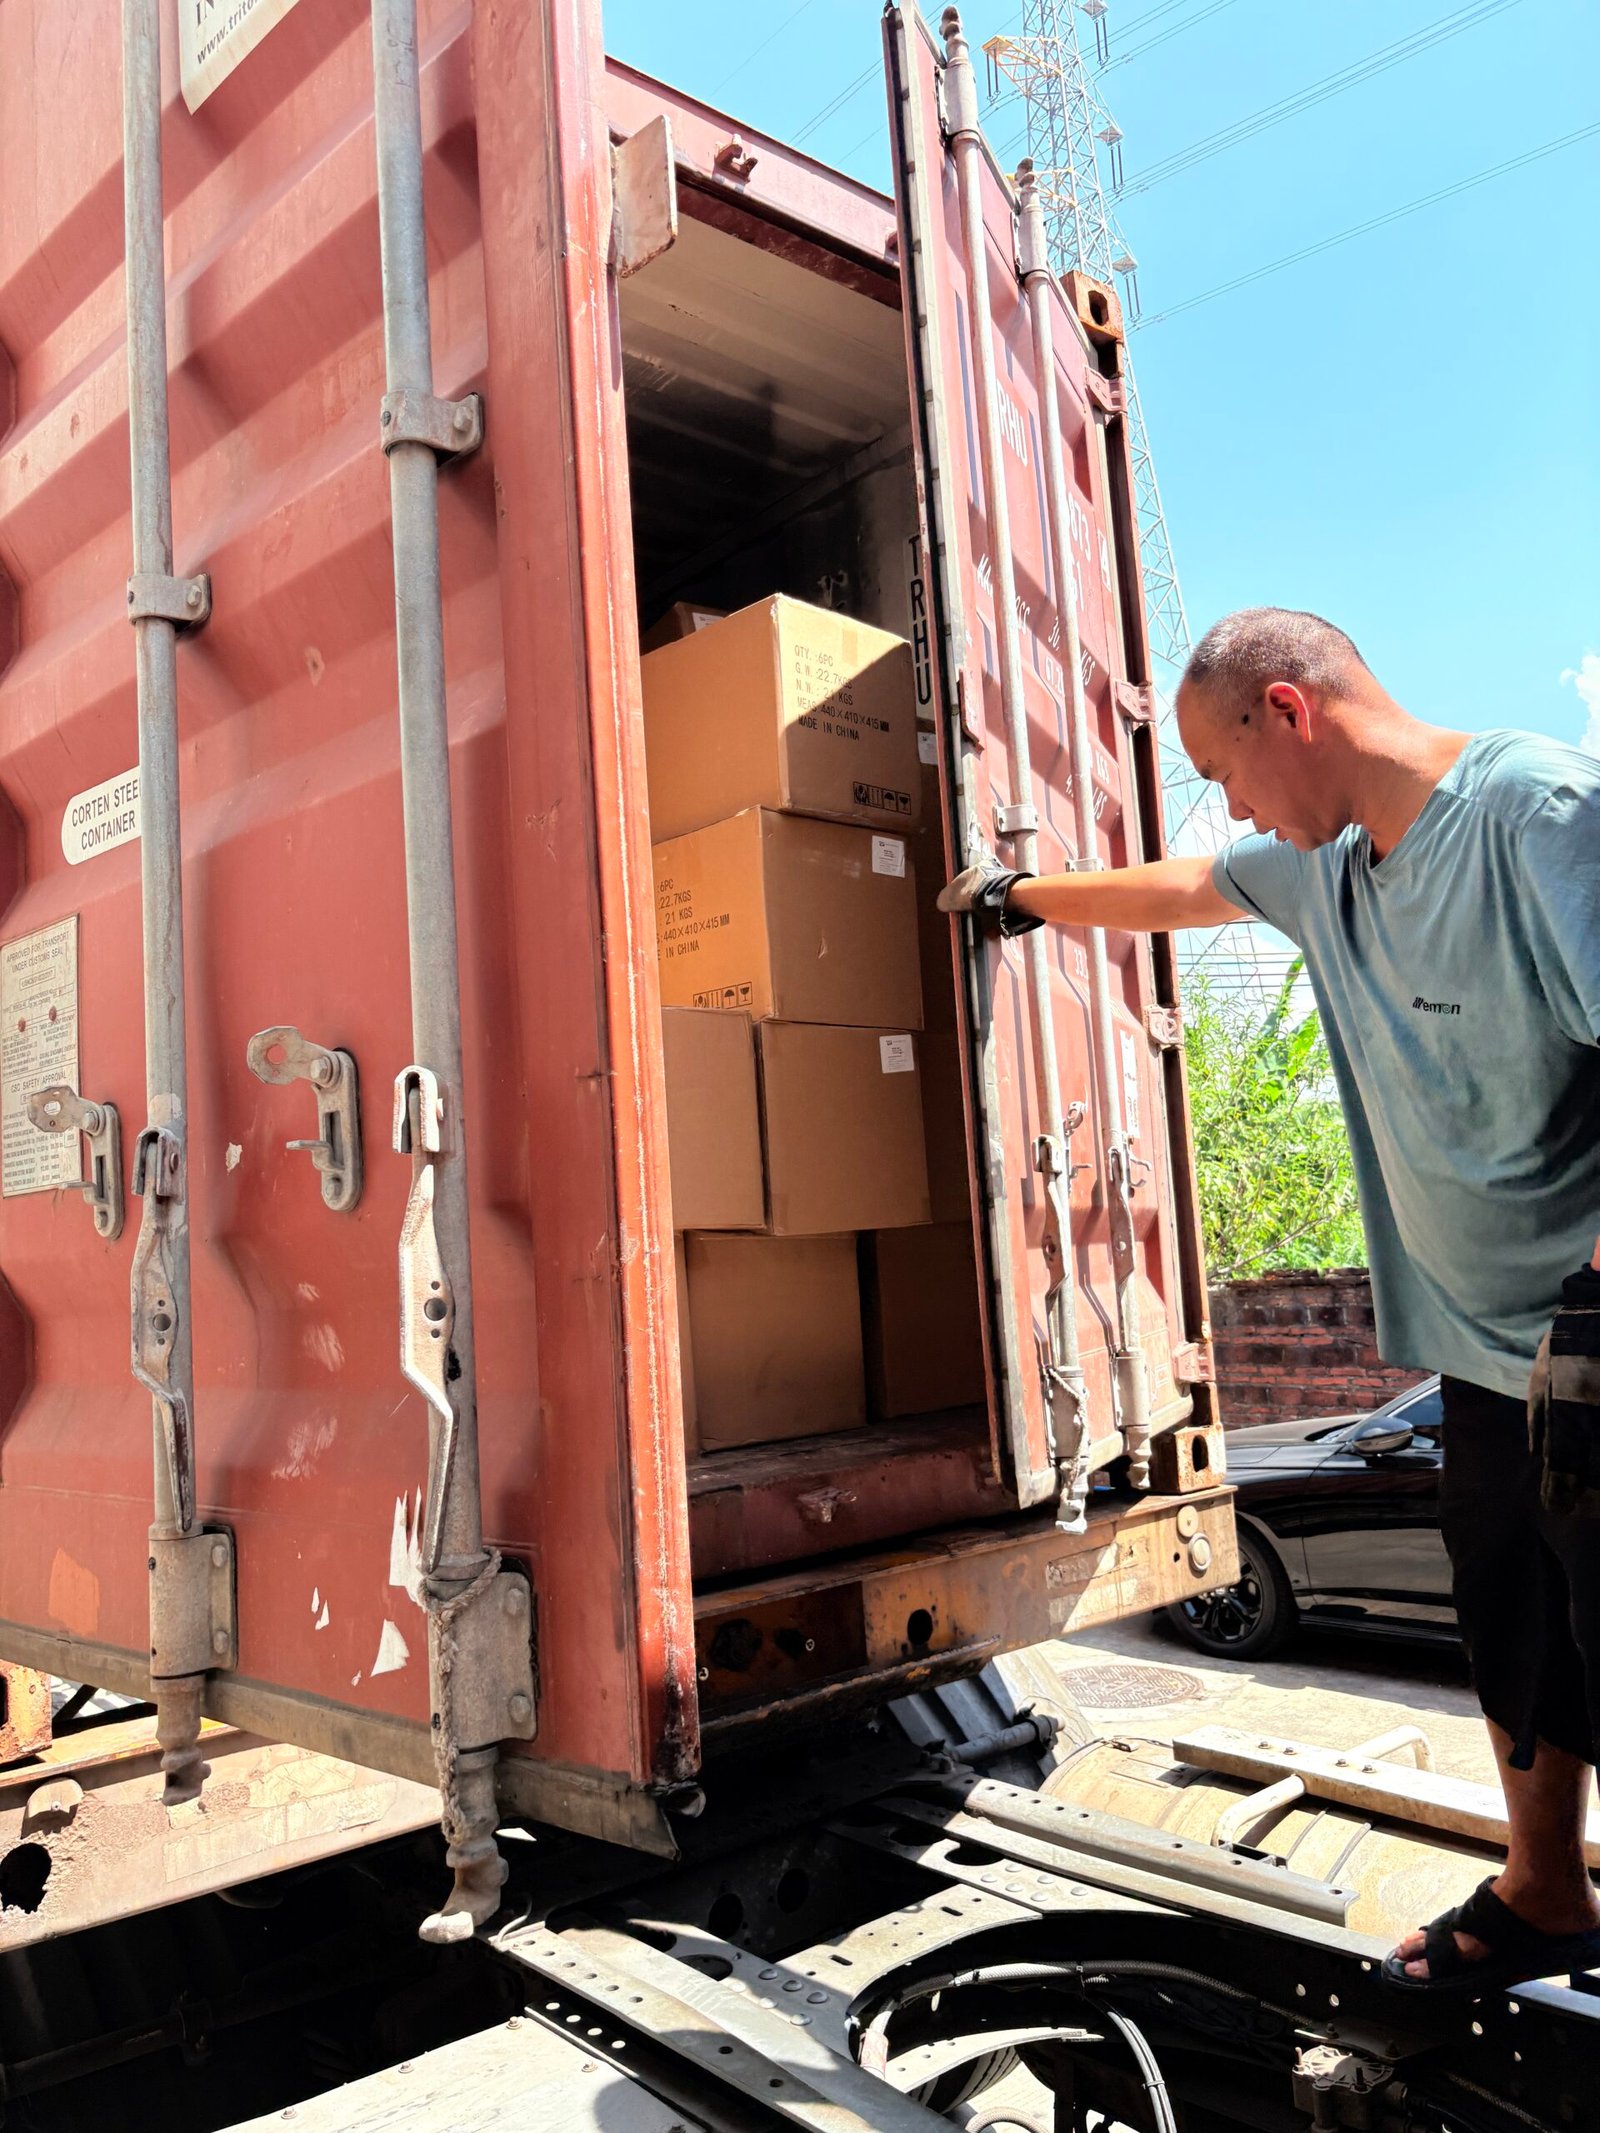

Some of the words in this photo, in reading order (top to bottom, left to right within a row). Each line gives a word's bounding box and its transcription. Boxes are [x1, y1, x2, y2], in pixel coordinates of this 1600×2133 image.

[197, 0, 258, 65] www.trito
[908, 534, 932, 705] TRHU
[797, 714, 818, 730] MADE
[823, 721, 832, 734] IN
[835, 724, 860, 741] CHINA
[72, 793, 110, 827] CORTEN
[114, 777, 141, 808] STEE
[81, 809, 136, 850] CONTAINER
[679, 906, 693, 920] KGS
[665, 946, 674, 959] IN
[677, 939, 700, 955] CHINA
[22, 1078, 40, 1091] SAFETY
[41, 1070, 67, 1085] APPROVAL
